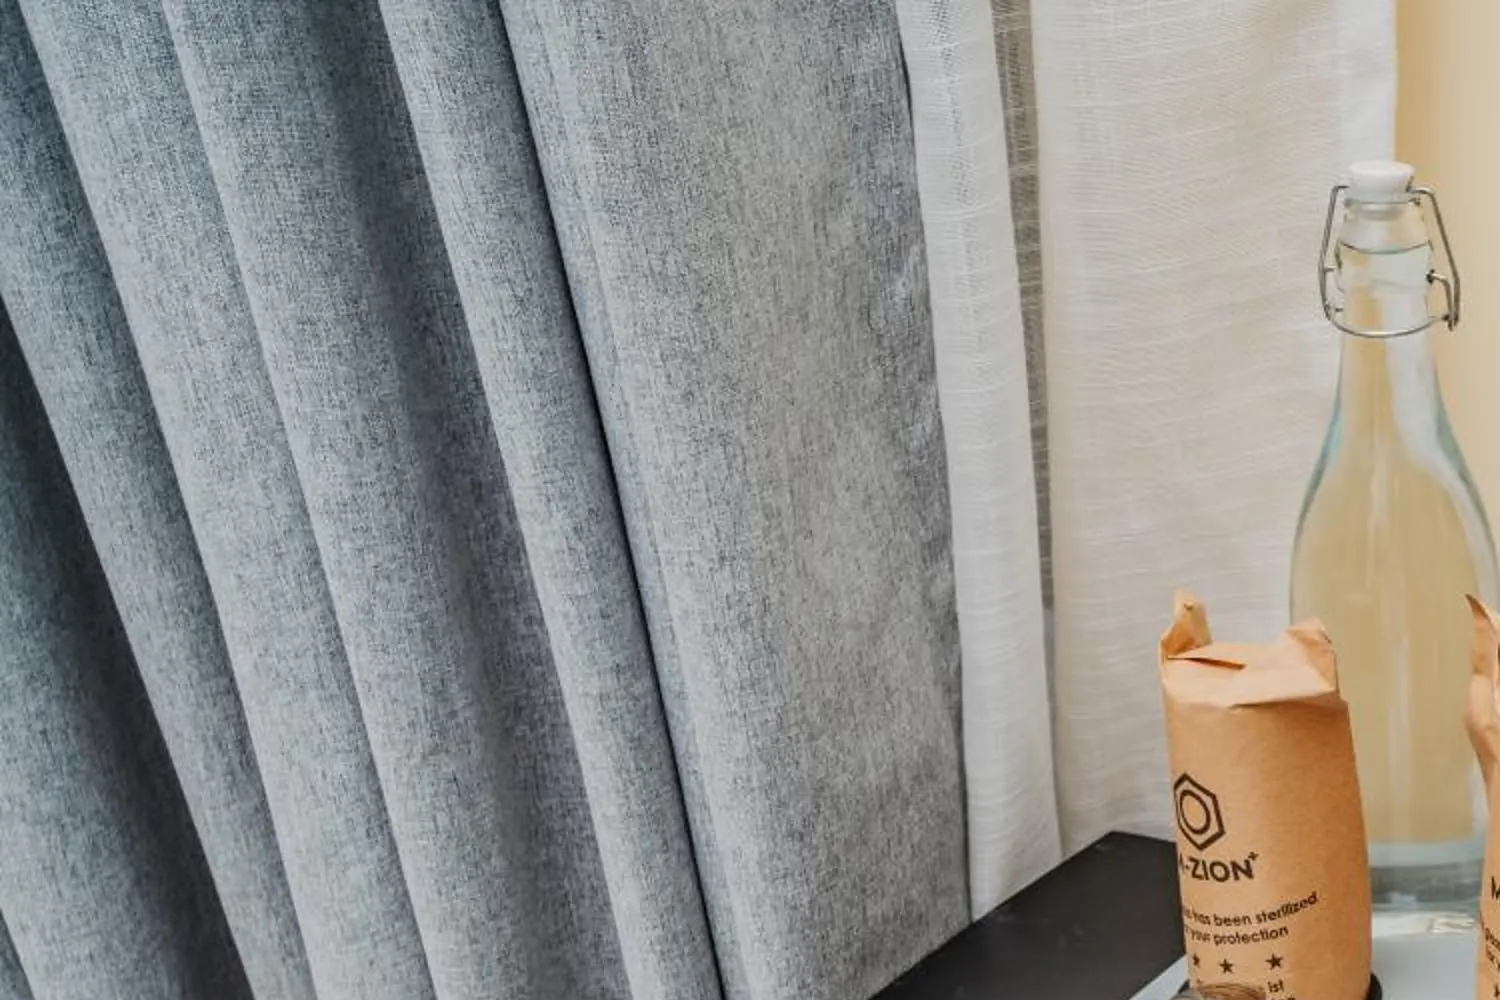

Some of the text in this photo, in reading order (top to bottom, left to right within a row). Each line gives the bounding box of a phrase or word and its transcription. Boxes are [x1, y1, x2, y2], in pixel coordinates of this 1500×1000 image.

[1213, 913, 1252, 928] been
[1254, 891, 1320, 925] sterilized
[1213, 925, 1290, 947] protection
[1267, 979, 1284, 994] ist
